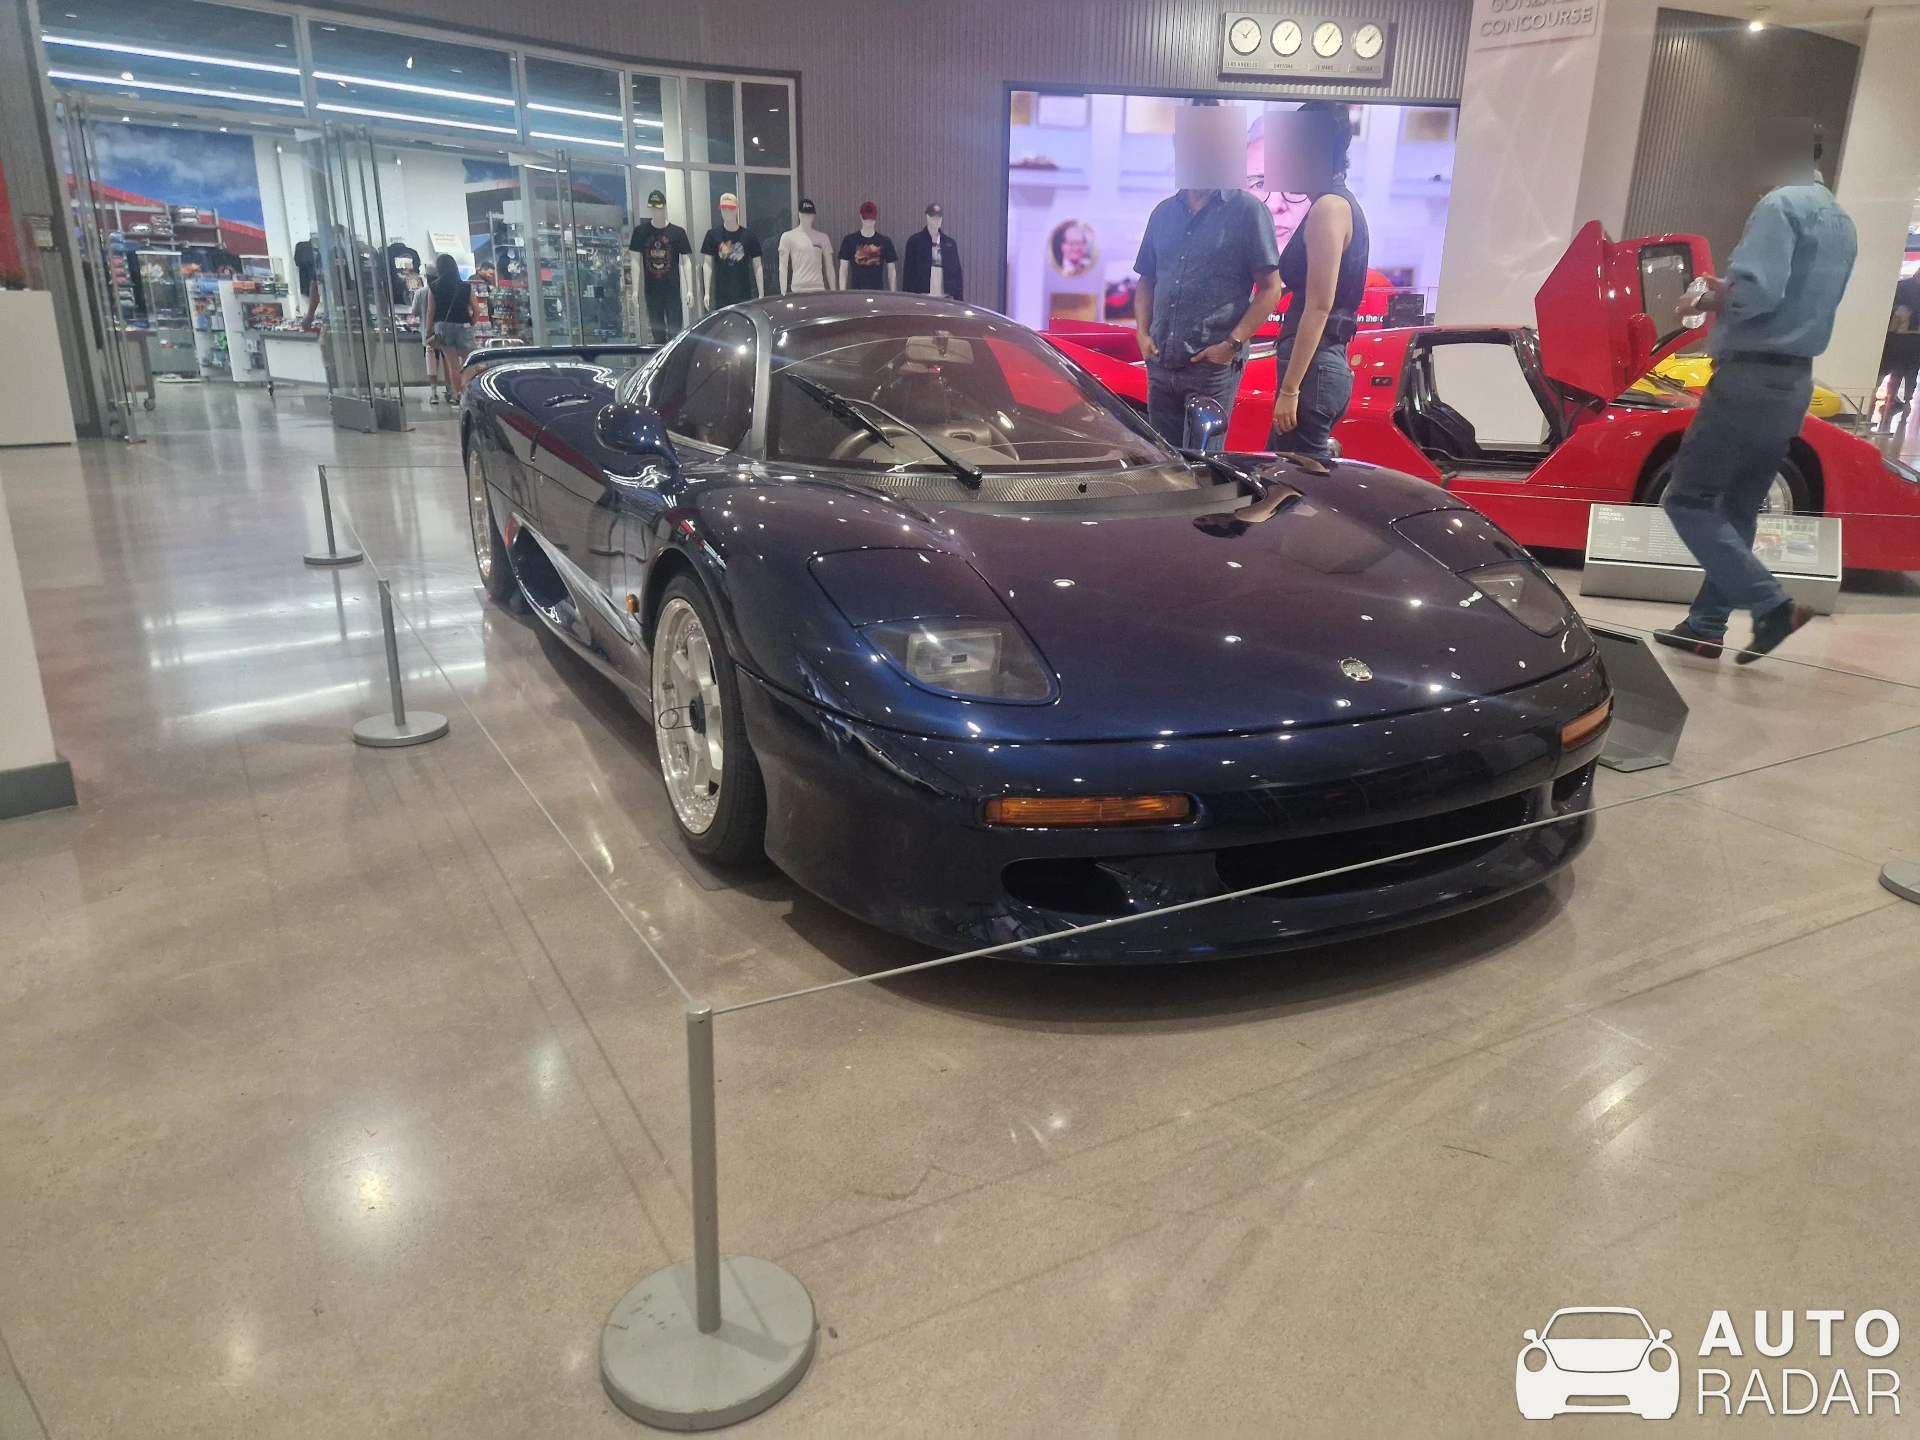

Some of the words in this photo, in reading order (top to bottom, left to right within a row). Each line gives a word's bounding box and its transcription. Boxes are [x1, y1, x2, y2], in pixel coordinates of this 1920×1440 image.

[1480, 6, 1594, 37] CONCOURSE
[1267, 313, 1281, 322] the
[1356, 314, 1365, 322] in
[1365, 314, 1378, 322] the
